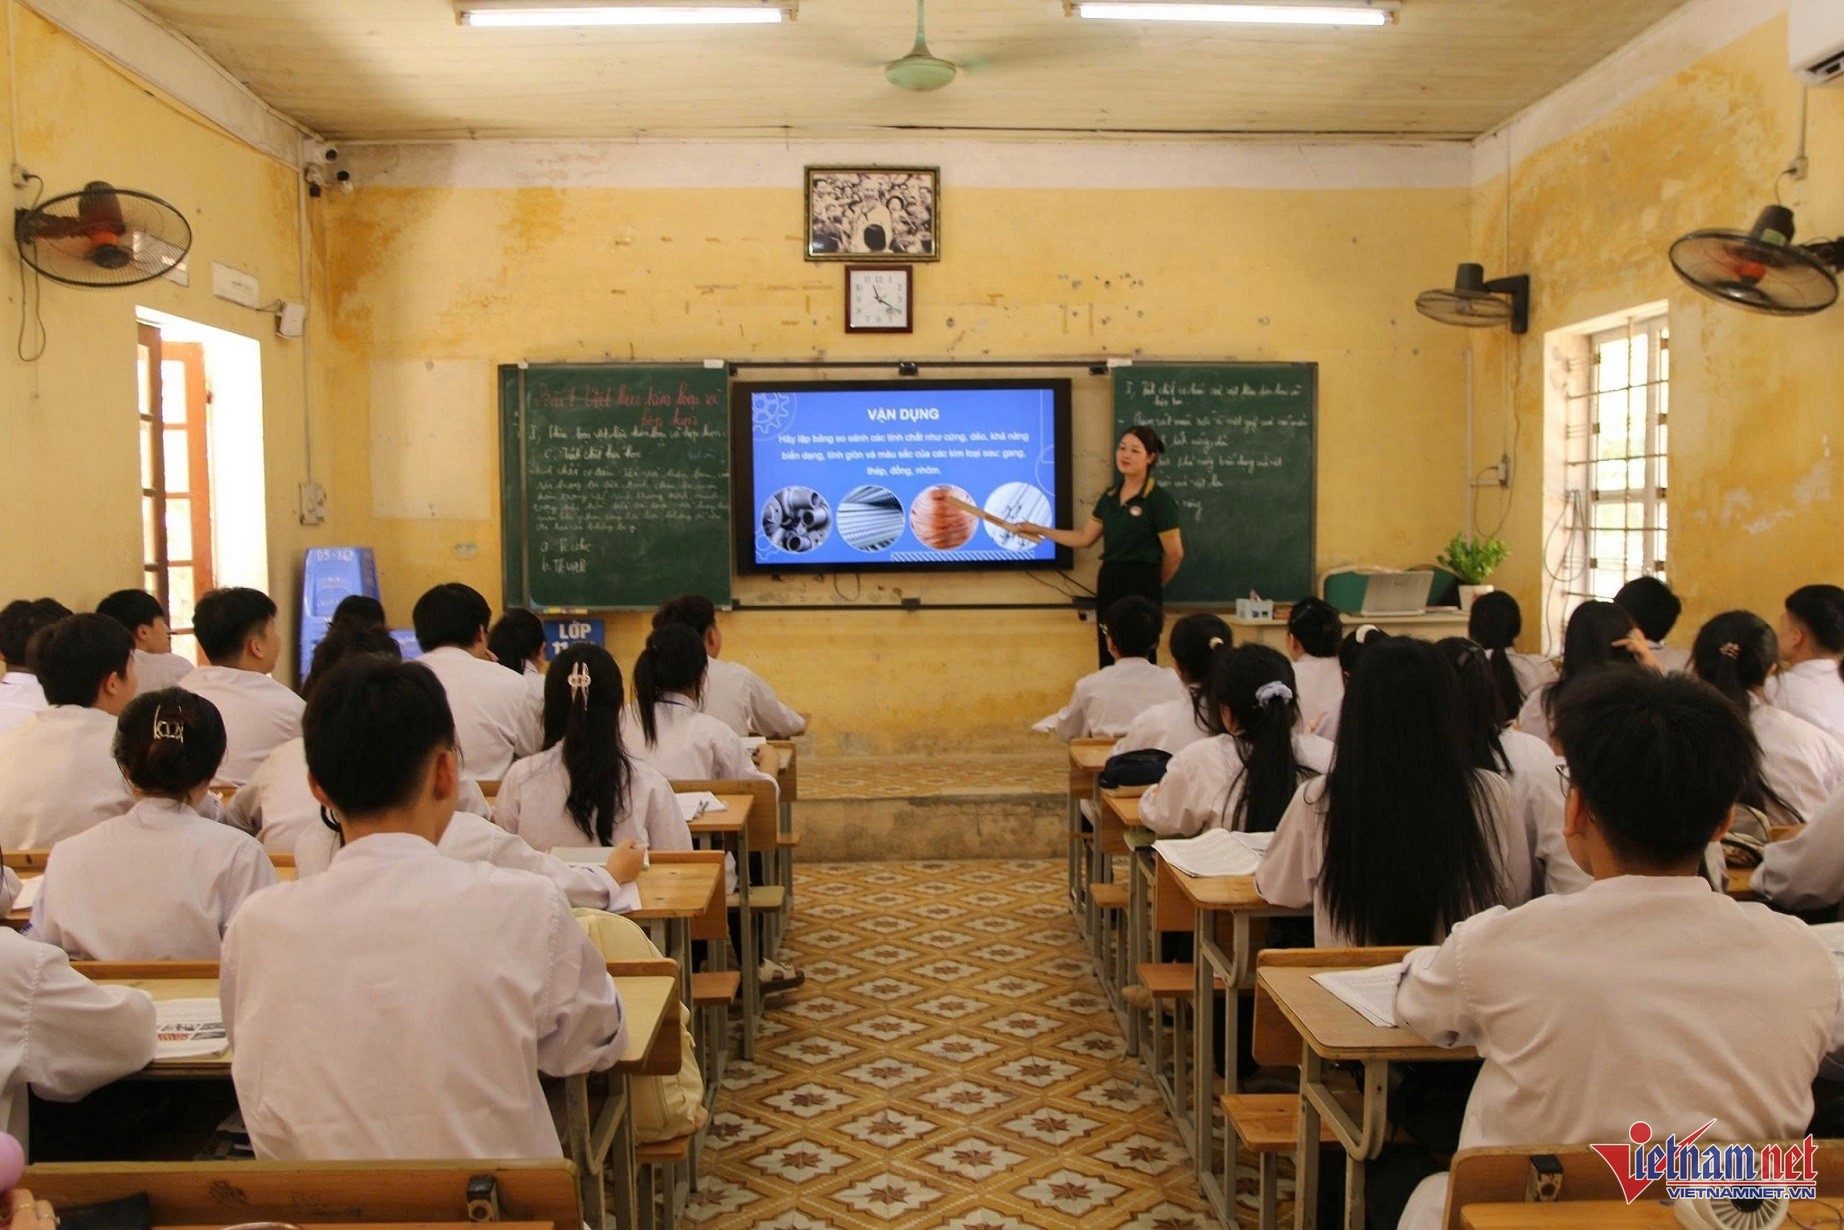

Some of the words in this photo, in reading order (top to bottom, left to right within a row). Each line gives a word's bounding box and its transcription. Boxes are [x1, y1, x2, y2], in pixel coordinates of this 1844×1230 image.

[866, 407, 897, 423] VẬN
[899, 407, 940, 423] DỤNG
[905, 431, 924, 442] chất
[781, 449, 800, 460] biến
[948, 449, 965, 459] kim
[558, 620, 592, 639] LỚP
